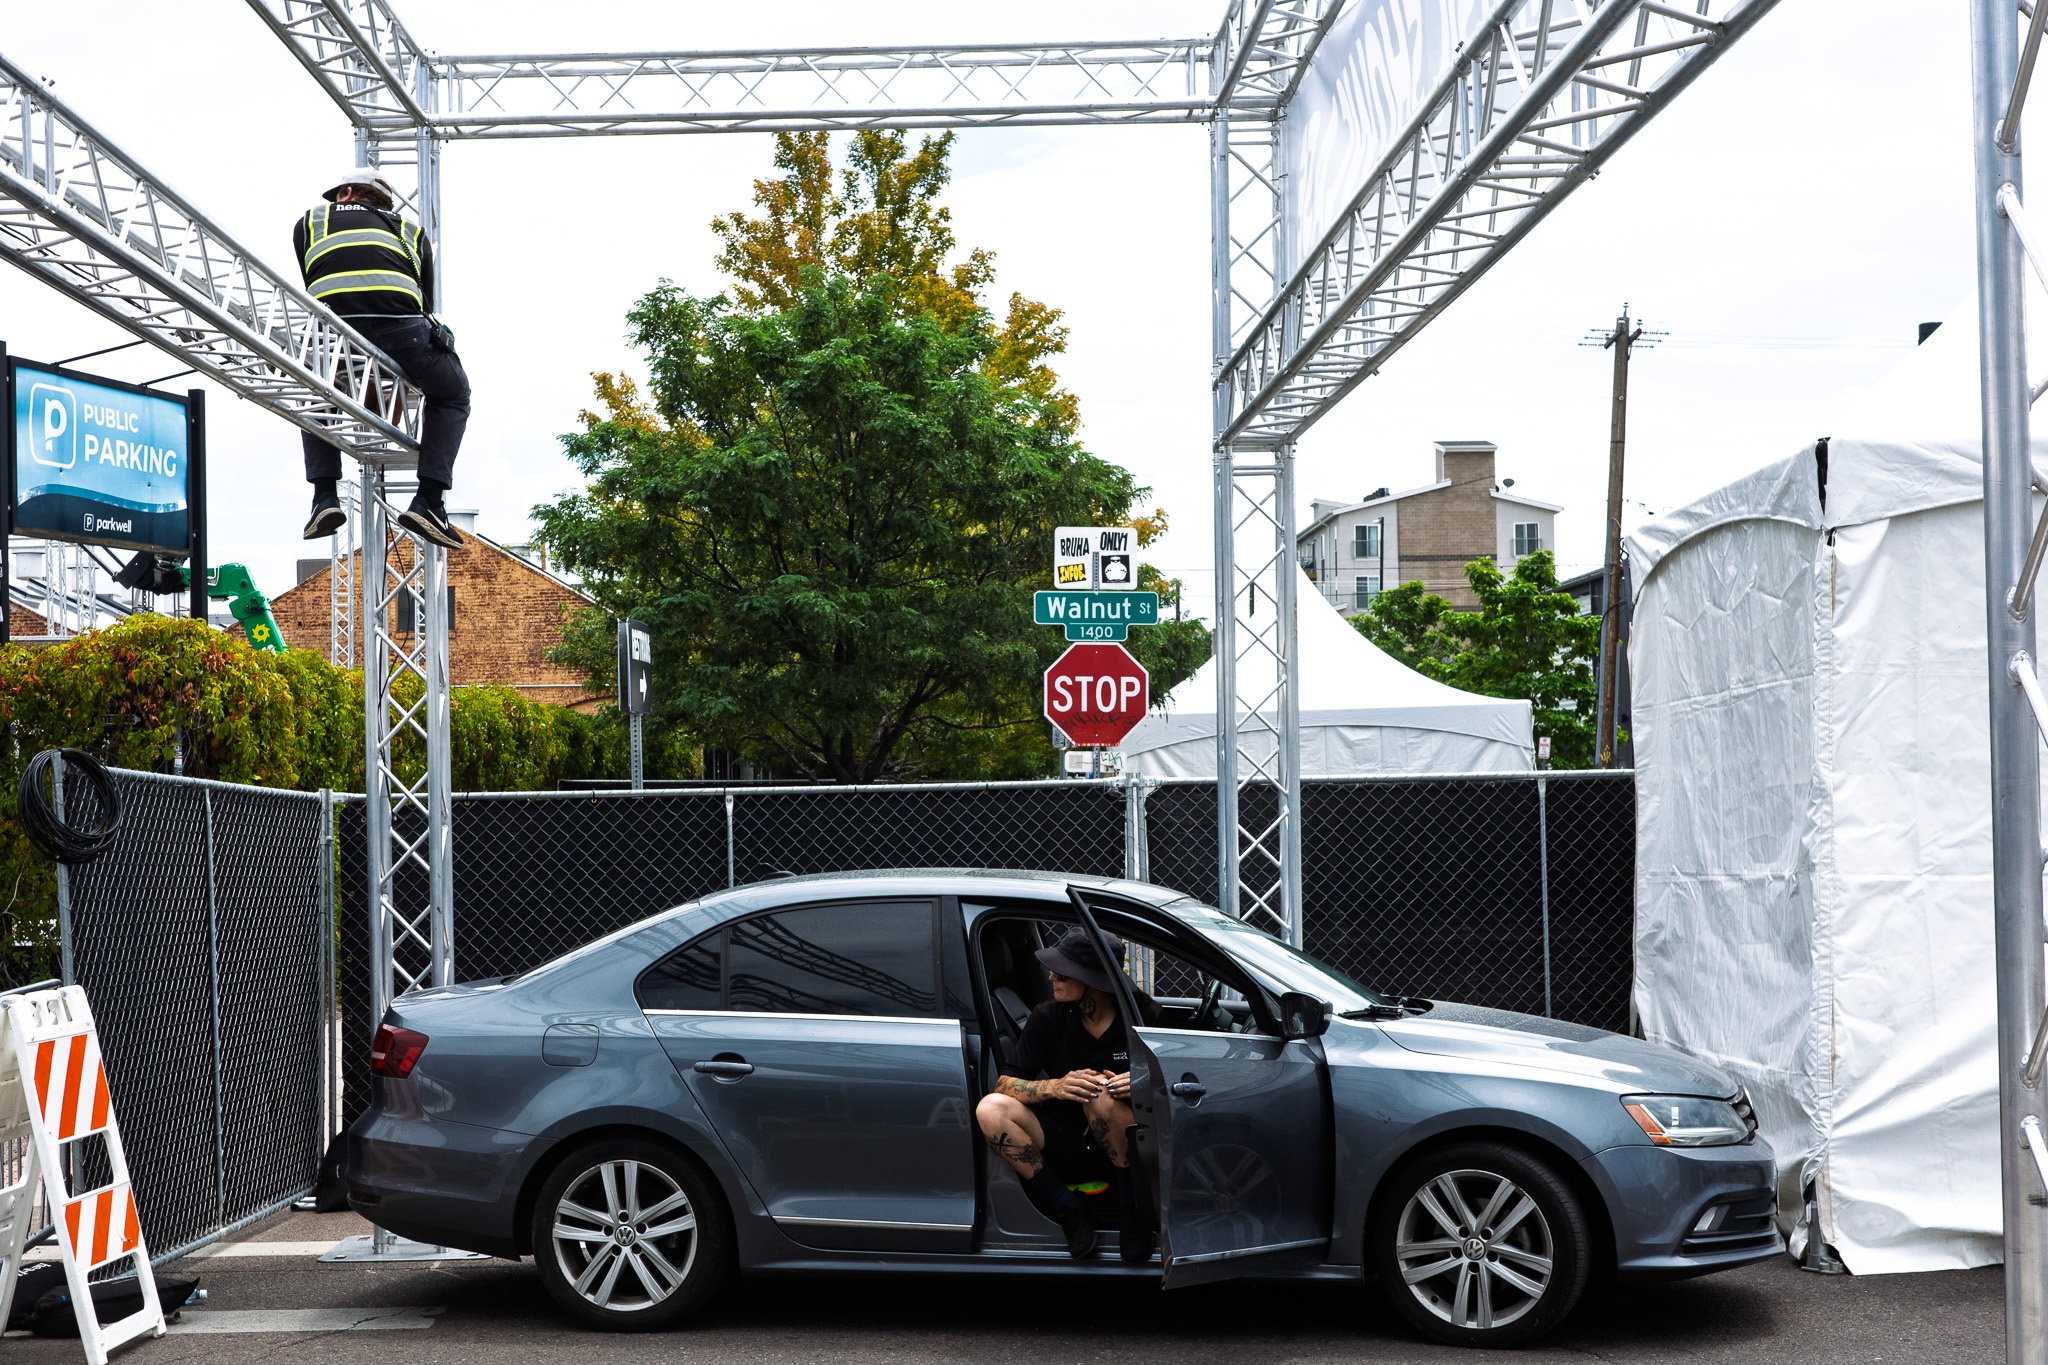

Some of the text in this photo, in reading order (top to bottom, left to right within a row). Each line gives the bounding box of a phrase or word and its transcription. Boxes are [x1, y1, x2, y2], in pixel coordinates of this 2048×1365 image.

[84, 403, 139, 433] PUBLIC
[84, 434, 177, 477] PARKING
[96, 517, 132, 534] parkwell
[1060, 537, 1090, 558] BRUHA
[1047, 596, 1151, 619] Walnut St
[1080, 626, 1113, 638] 1400
[1052, 675, 1141, 713] STOP
